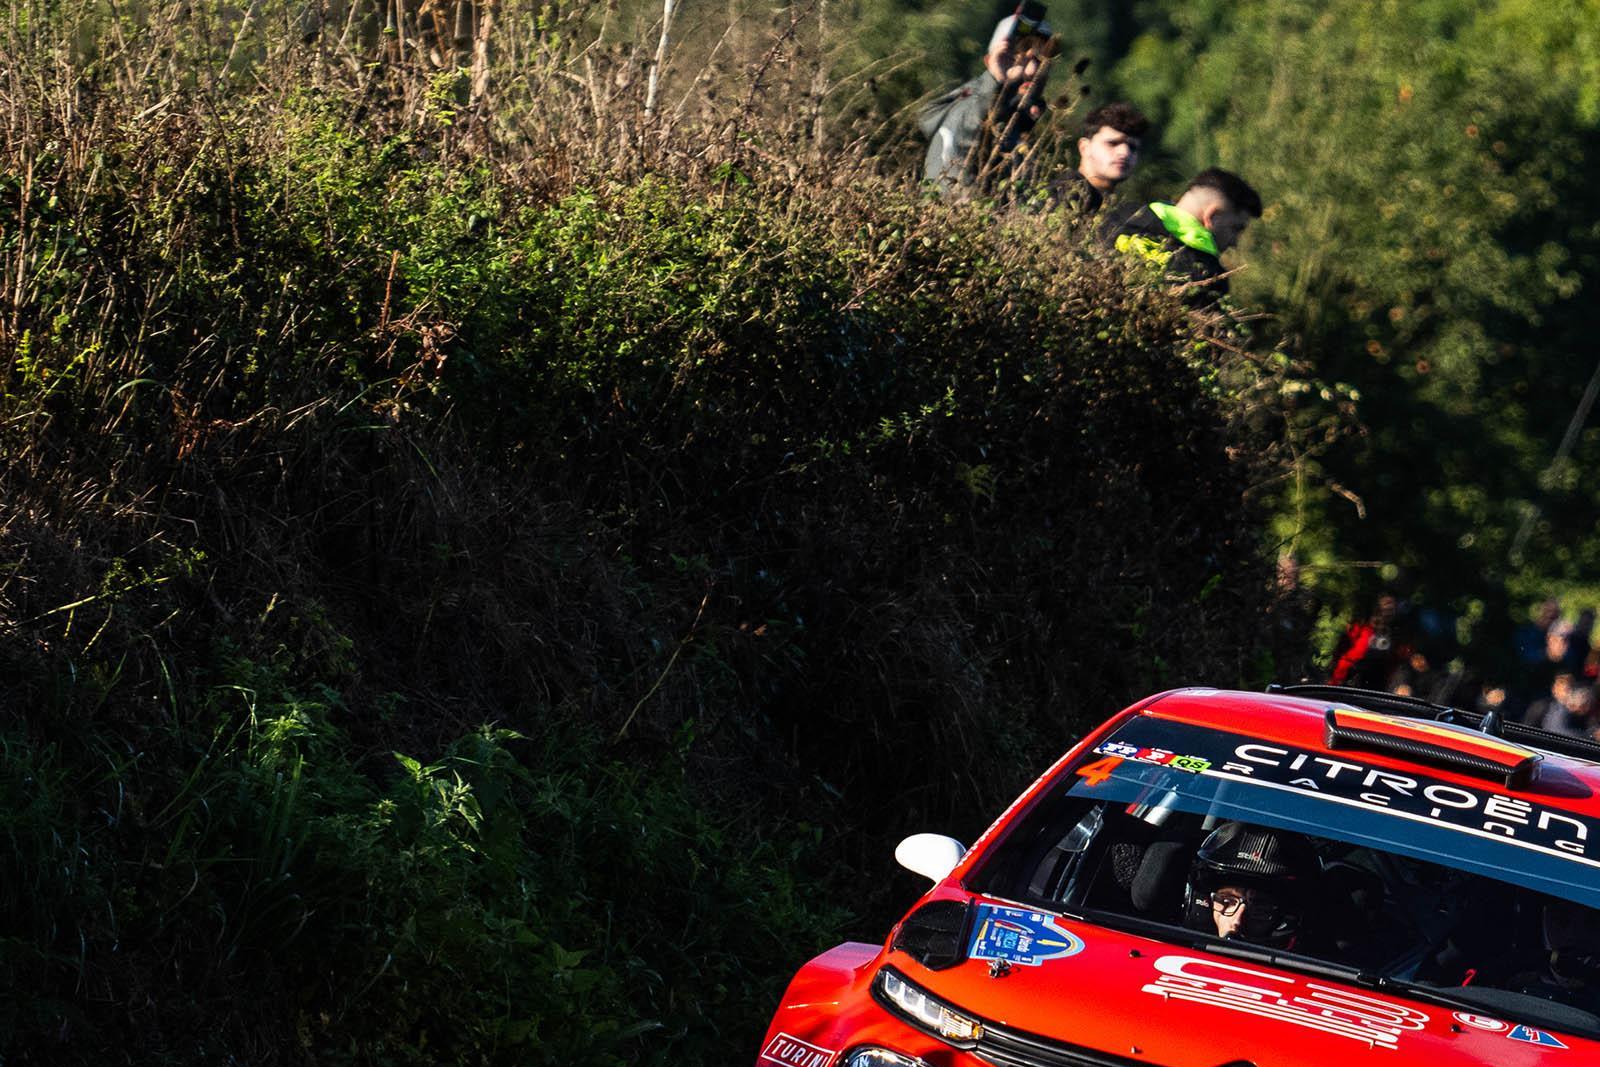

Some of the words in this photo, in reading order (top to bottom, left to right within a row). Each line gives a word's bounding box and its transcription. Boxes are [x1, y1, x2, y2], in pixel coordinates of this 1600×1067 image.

[1075, 756, 1124, 787] 4
[1176, 758, 1204, 770] QS
[1234, 743, 1589, 841] CITROËN
[1222, 761, 1585, 854] RACING
